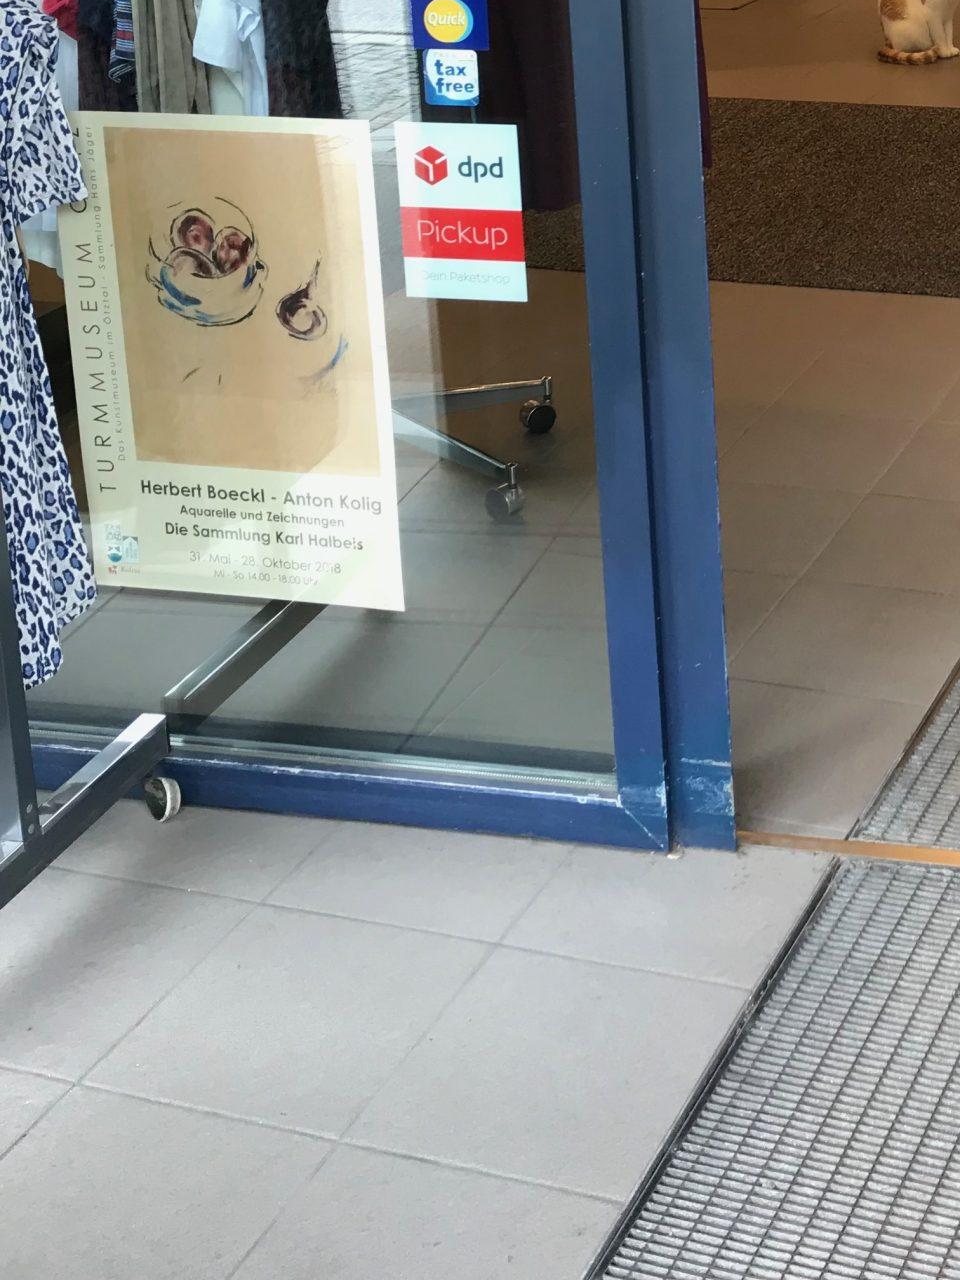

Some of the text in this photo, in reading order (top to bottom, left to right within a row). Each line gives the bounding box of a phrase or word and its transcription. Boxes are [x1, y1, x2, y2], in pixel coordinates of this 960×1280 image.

[427, 11, 465, 26] Quick
[434, 59, 467, 76] tax
[436, 77, 475, 94] free
[458, 155, 504, 183] dpd
[90, 169, 99, 199] Hans
[94, 205, 106, 270] Sammlung
[417, 220, 508, 250] Pickup
[75, 242, 117, 493] TURMMUSEUM
[108, 351, 123, 434] Kunstmuseum
[117, 439, 126, 461] Das
[140, 479, 202, 498] Herbert
[207, 485, 265, 503] Boeckl
[283, 491, 334, 508] Anton
[339, 495, 382, 515] Kolig
[180, 505, 345, 528] Aquarelle und Zeichnungen
[165, 522, 188, 536] Die
[192, 524, 271, 546] Sammlung
[275, 531, 304, 546] Karl
[208, 553, 232, 565] Mai
[262, 557, 311, 572] Oktober
